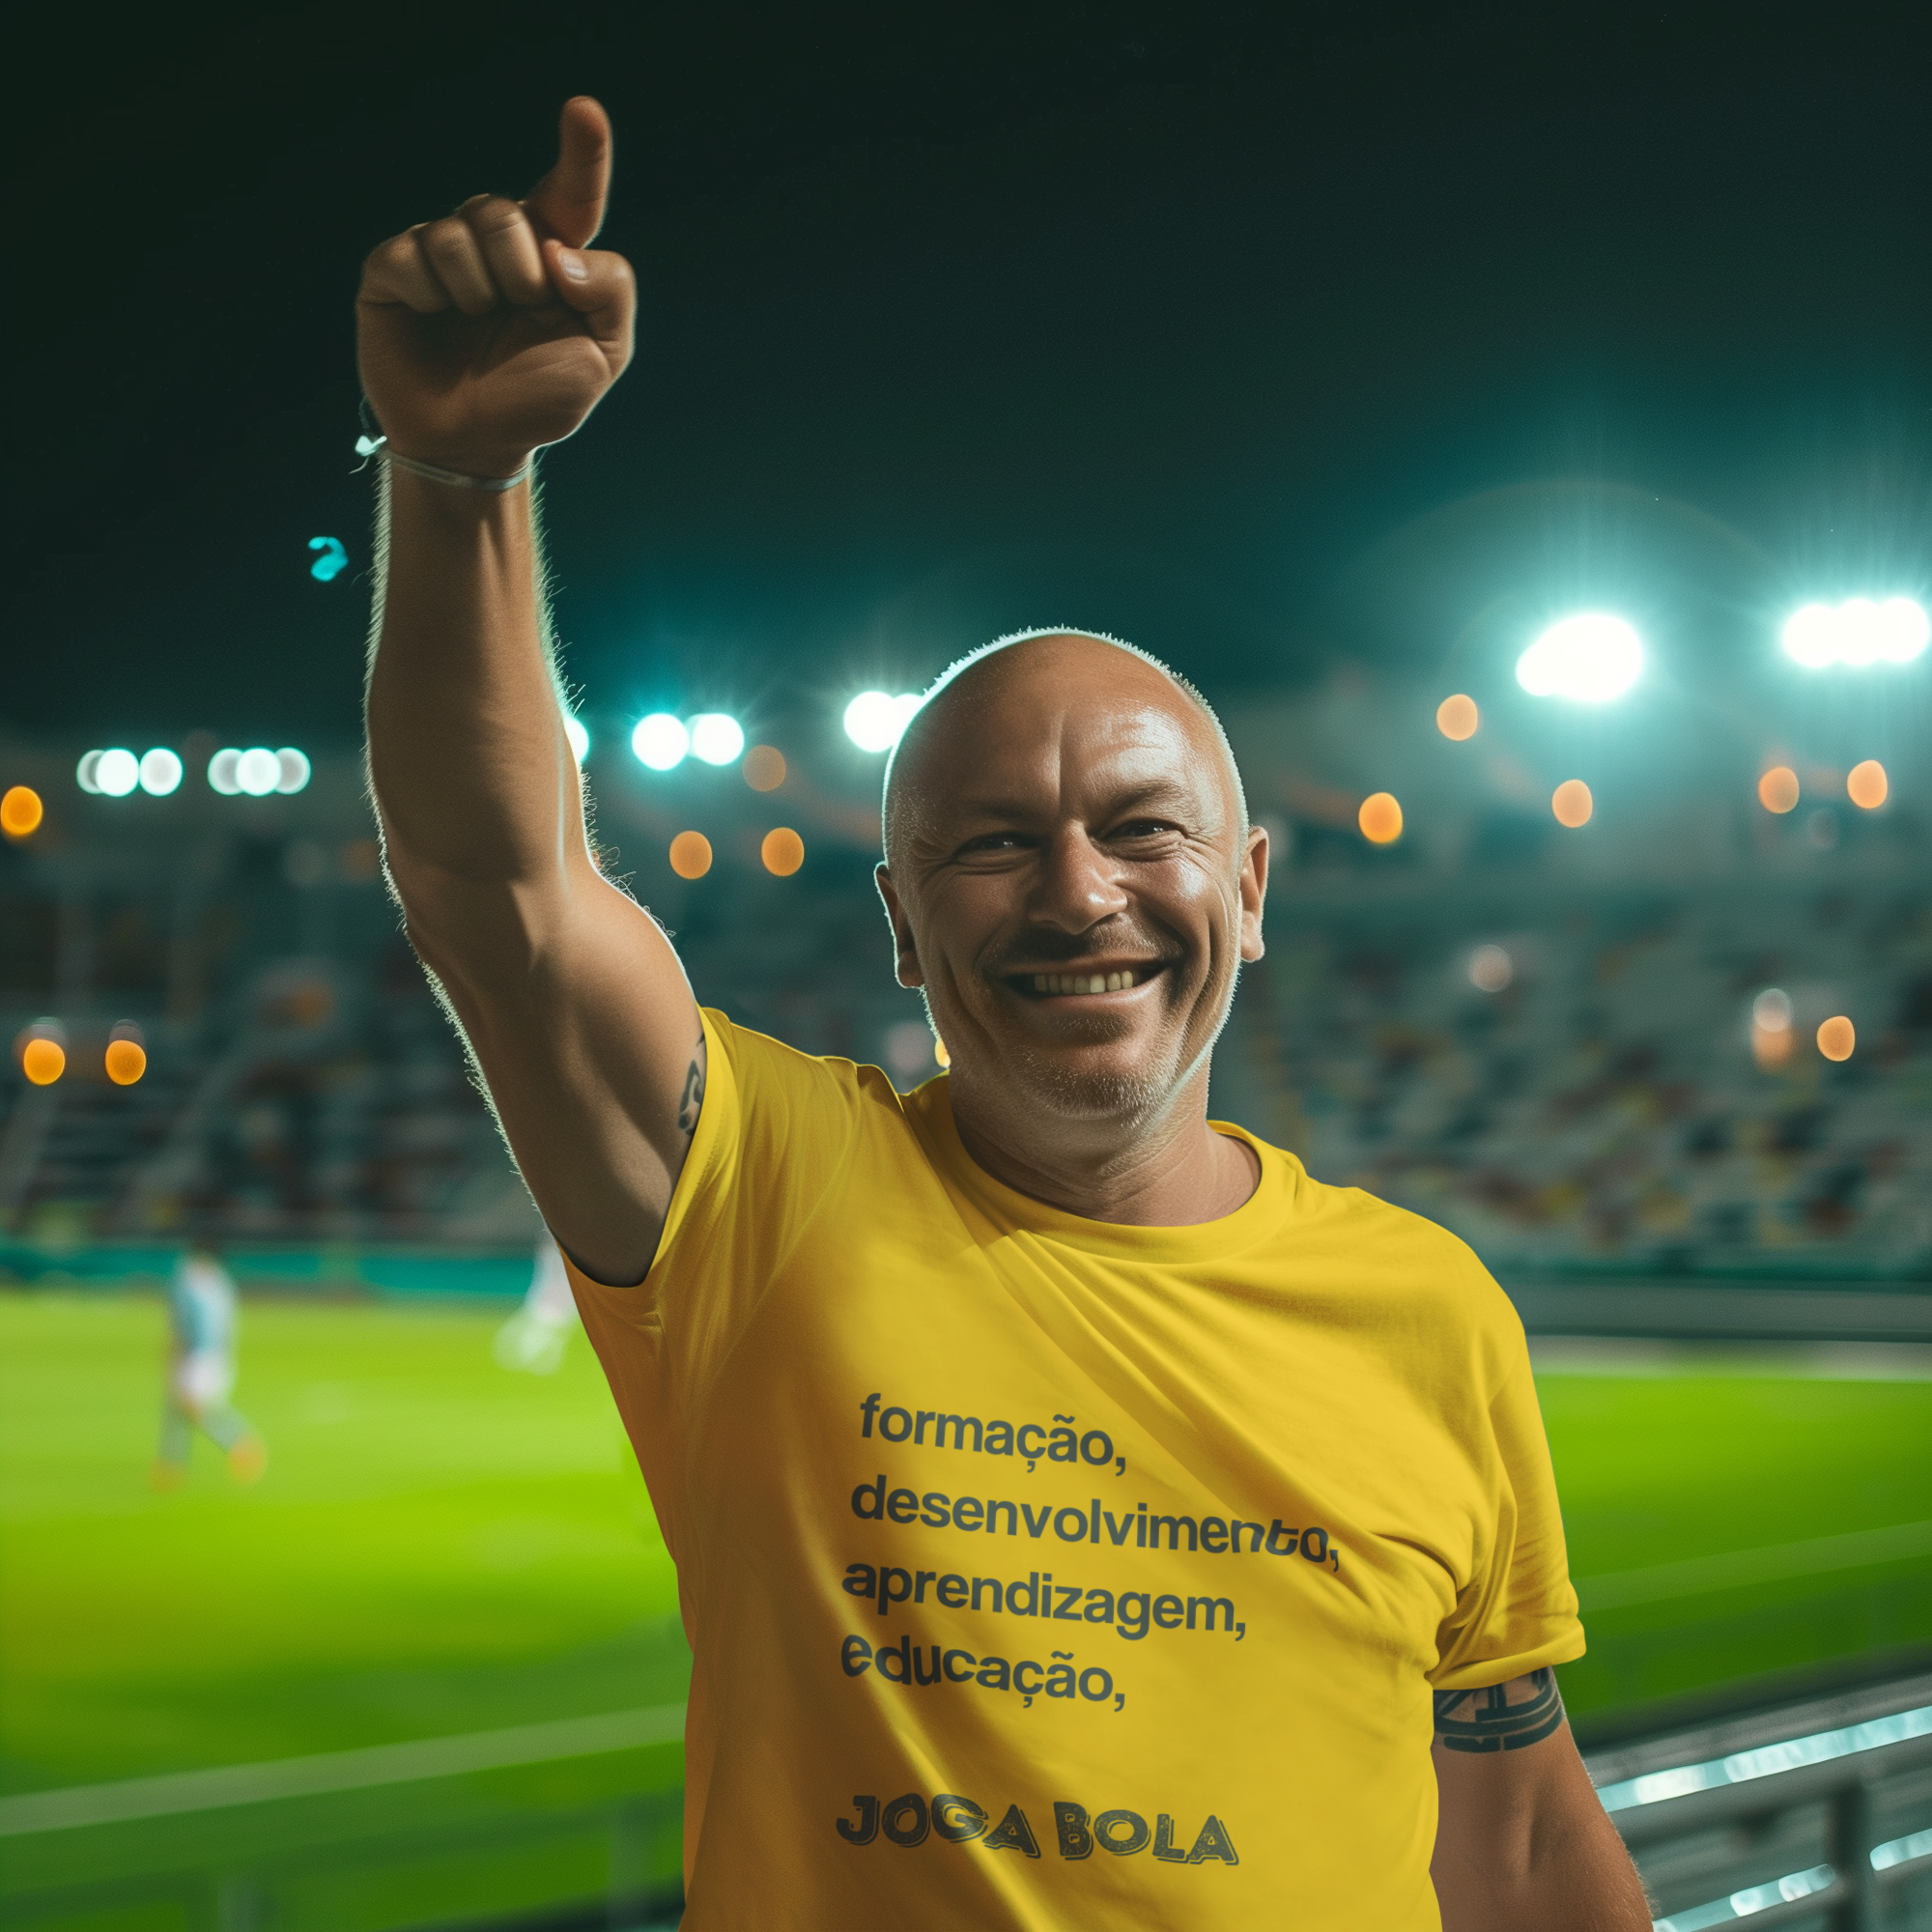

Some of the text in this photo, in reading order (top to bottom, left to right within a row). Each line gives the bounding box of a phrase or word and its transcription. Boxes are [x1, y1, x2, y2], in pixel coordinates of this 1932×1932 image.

[860, 1393, 1127, 1477] formação,
[850, 1474, 1340, 1572] desenvolvimento,
[841, 1560, 1247, 1641] aprendizagem,
[840, 1634, 1126, 1712] educação,
[836, 1792, 1239, 1865] JOGA BOLA
